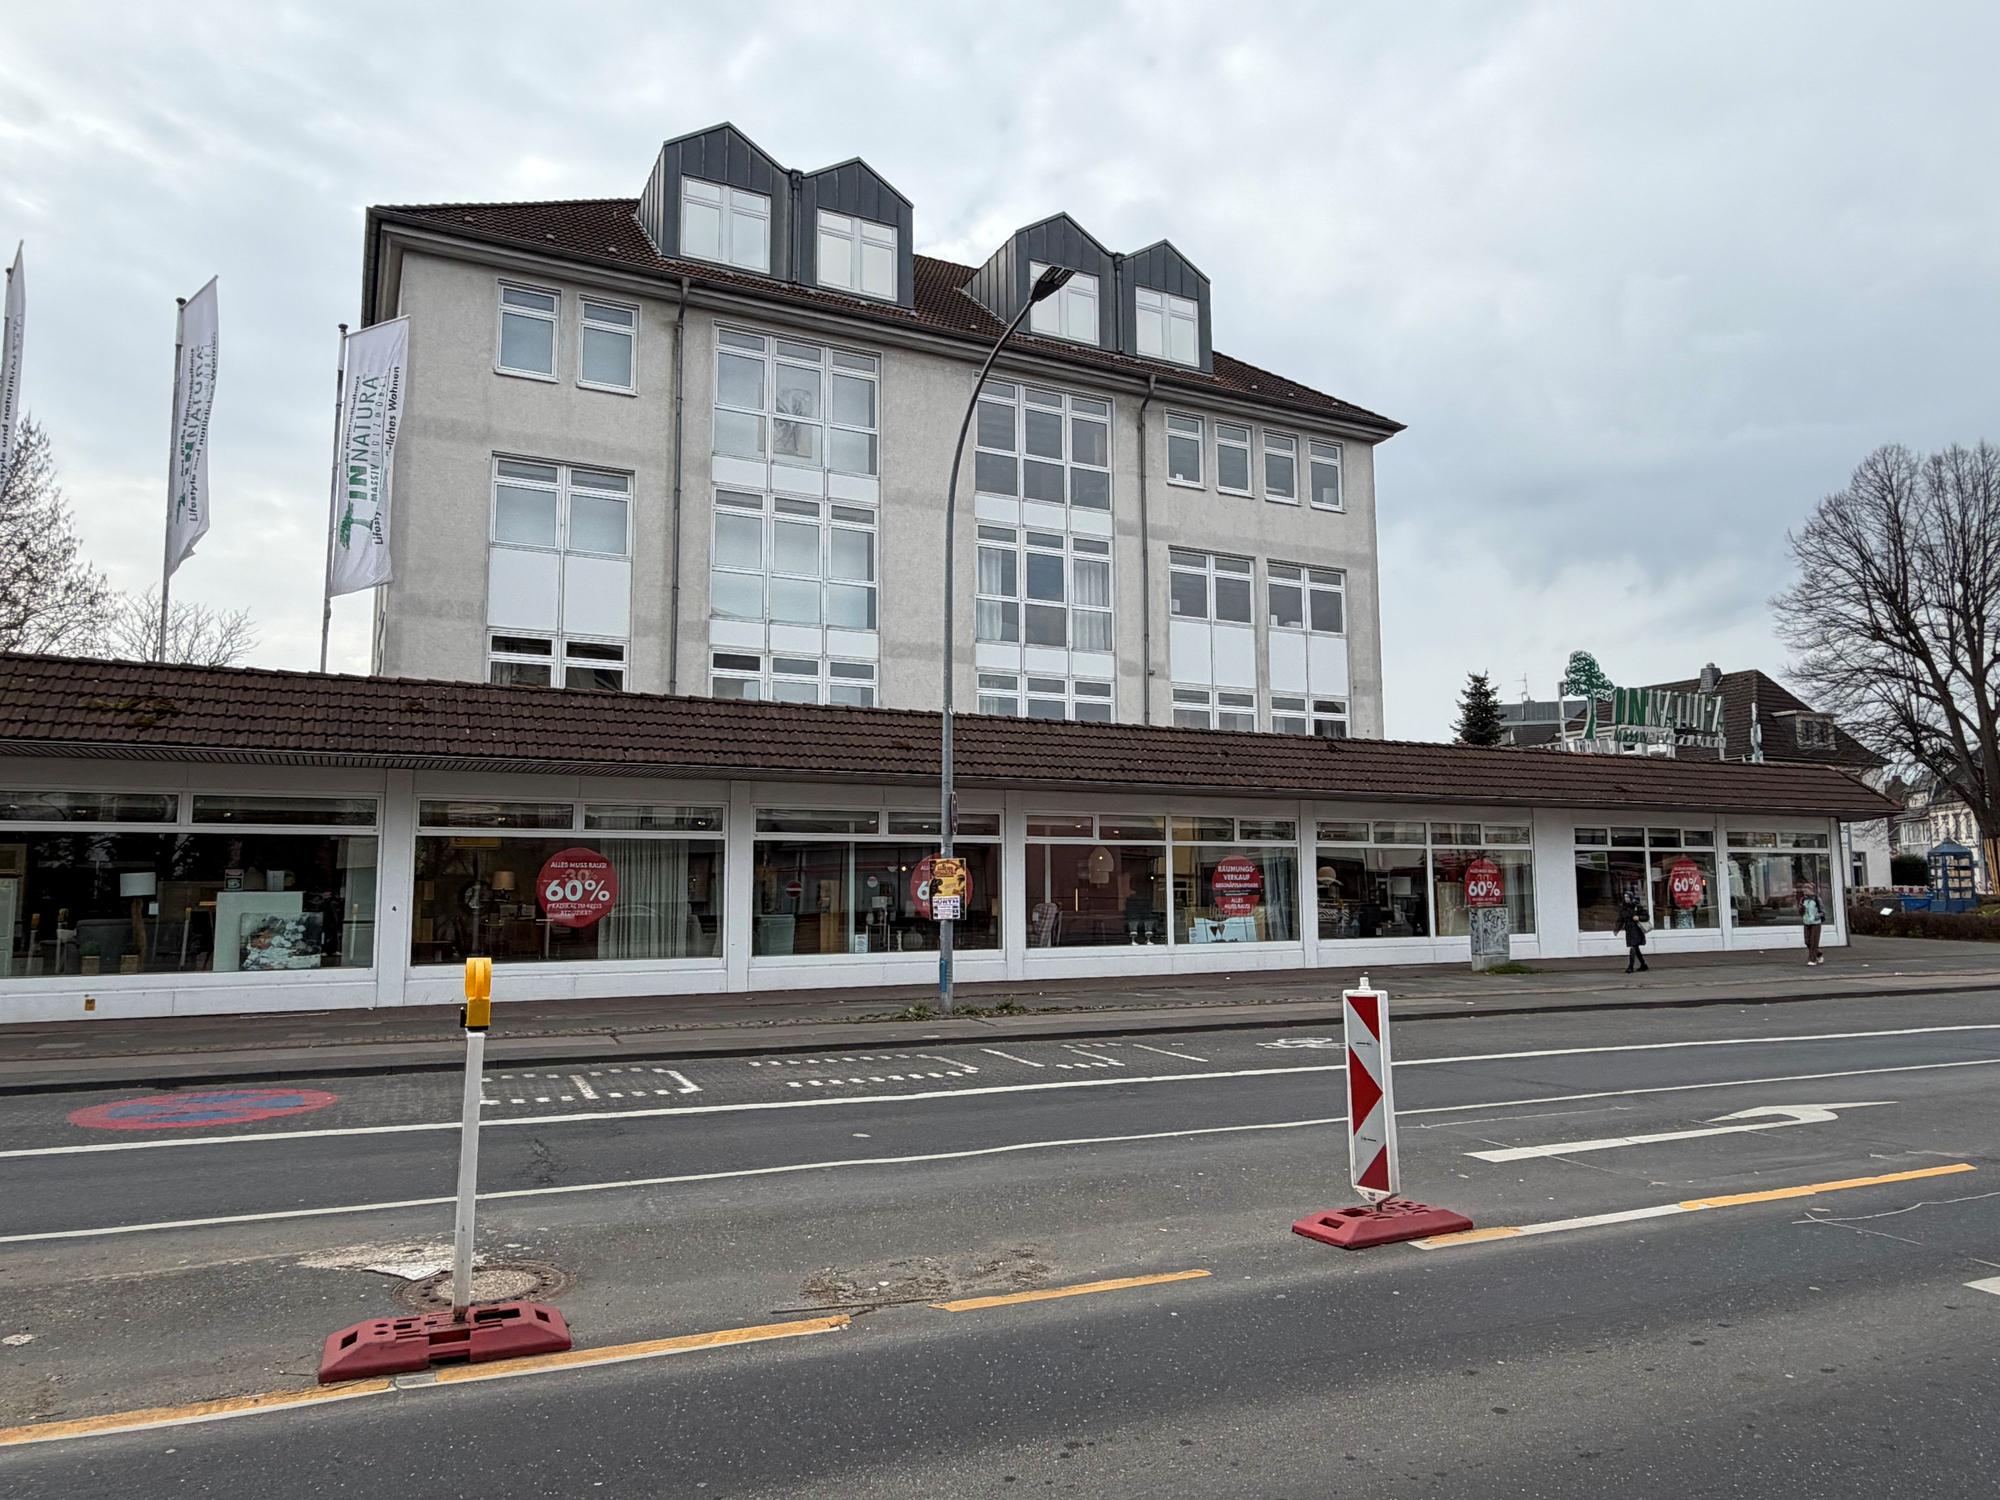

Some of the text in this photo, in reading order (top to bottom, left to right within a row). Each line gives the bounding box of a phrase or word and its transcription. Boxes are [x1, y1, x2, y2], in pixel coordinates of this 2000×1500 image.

[387, 366, 400, 411] Wohnen
[349, 376, 379, 501] INNATURA
[188, 474, 198, 522] Lifestyle
[545, 880, 610, 902] 60%
[1469, 881, 1500, 897] 60%
[1674, 878, 1700, 891] 60%
